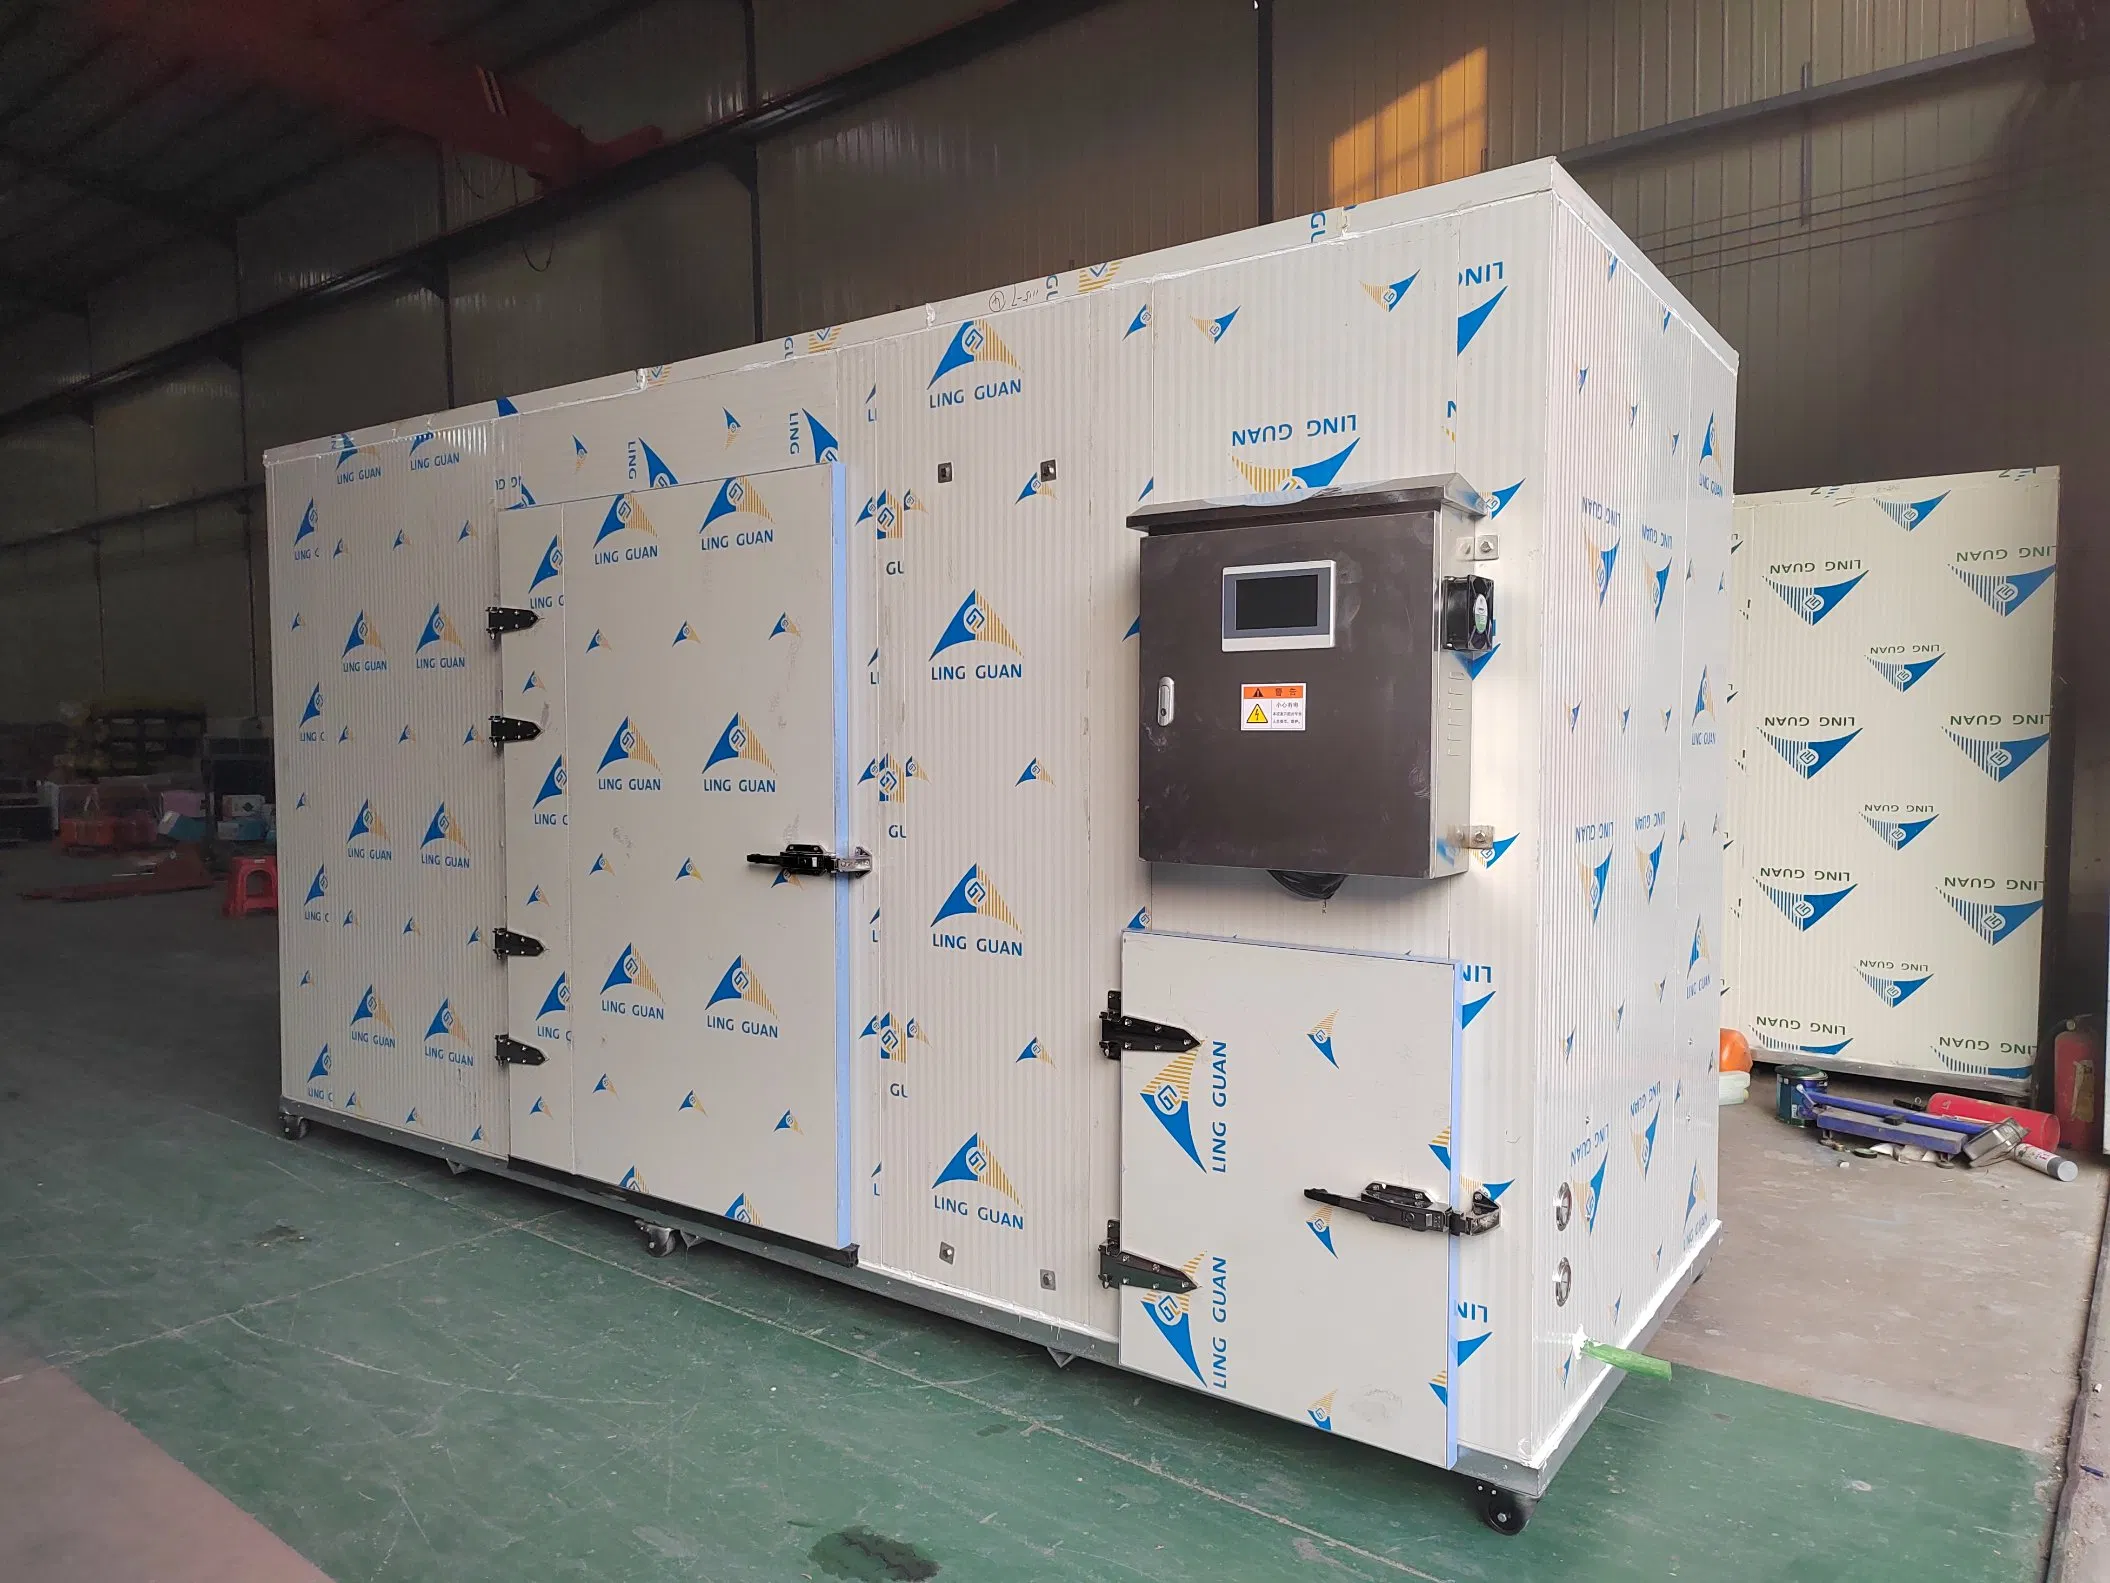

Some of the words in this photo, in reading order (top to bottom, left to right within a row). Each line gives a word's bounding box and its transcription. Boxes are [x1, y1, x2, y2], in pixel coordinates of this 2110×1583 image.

[930, 390, 964, 408] LING
[975, 379, 1021, 400] GUAN
[1307, 415, 1356, 436] LING
[790, 413, 799, 454] LING
[1233, 424, 1292, 446] GUAN
[411, 458, 429, 470] LING
[434, 453, 459, 466] GUAN
[628, 442, 636, 479] LING
[337, 472, 354, 484] LING
[359, 467, 381, 479] GUAN
[1582, 496, 1602, 520] GUAN
[1606, 508, 1621, 529] LING
[702, 536, 728, 550] LING
[737, 530, 773, 546] GUAN
[295, 549, 310, 560] LING
[595, 551, 618, 564] LING
[626, 546, 657, 560] GUAN
[1957, 549, 2007, 562] GUAN
[1771, 563, 1815, 574] GUAN
[1826, 560, 1860, 571] LING
[530, 596, 552, 609] LING
[1871, 646, 1905, 654] GUAN
[343, 662, 360, 672] LING
[365, 661, 387, 671] GUAN
[417, 658, 435, 669] LING
[440, 657, 464, 668] GUAN
[932, 666, 965, 680] LING
[976, 664, 1021, 679] GUAN
[1765, 717, 1809, 726] GUAN
[1820, 717, 1854, 726] LING
[1951, 715, 2001, 725] GUAN
[300, 732, 316, 741] LING
[599, 779, 622, 790] LING
[629, 779, 660, 790] GUAN
[704, 780, 731, 791] LING
[739, 780, 775, 792] GUAN
[535, 814, 556, 825] LING
[1575, 824, 1596, 843] GUAN
[1600, 822, 1614, 839] LING
[348, 848, 364, 858] LING
[370, 850, 391, 860] GUAN
[422, 854, 440, 865] LING
[445, 857, 469, 868] GUAN
[1761, 868, 1804, 878] GUAN
[1815, 871, 1849, 881] LING
[1945, 877, 1995, 888] GUAN
[305, 911, 321, 921] LING
[933, 934, 966, 949] LING
[977, 939, 1022, 956] GUAN
[1860, 960, 1894, 969] GUAN
[1902, 963, 1928, 971] LING
[602, 1000, 625, 1014] LING
[632, 1005, 663, 1020] GUAN
[708, 1015, 734, 1030] LING
[742, 1021, 777, 1038] GUAN
[1757, 1016, 1800, 1029] GUAN
[1811, 1023, 1845, 1035] LING
[538, 1026, 559, 1039] LING
[352, 1031, 368, 1042] LING
[373, 1035, 395, 1048] GUAN
[1940, 1037, 1989, 1050] GUAN
[425, 1046, 443, 1059] LING
[449, 1052, 473, 1066] GUAN
[1213, 1041, 1226, 1107] GUAN
[308, 1088, 324, 1099] LING
[1213, 1122, 1226, 1172] LING
[935, 1195, 967, 1215] LING
[978, 1207, 1023, 1229] GUAN
[1213, 1257, 1226, 1322] GUAN
[1213, 1337, 1226, 1388] LING
